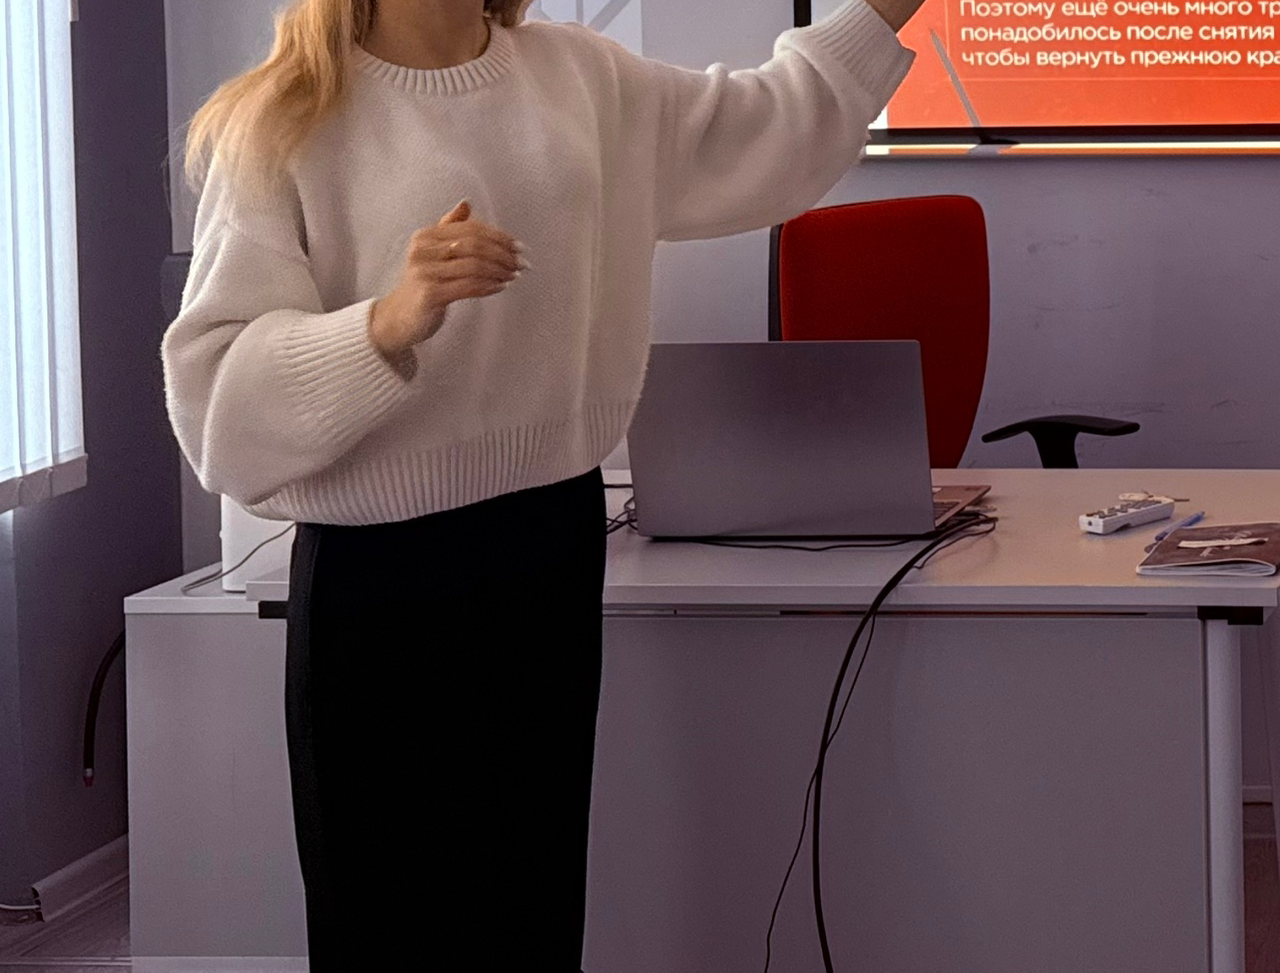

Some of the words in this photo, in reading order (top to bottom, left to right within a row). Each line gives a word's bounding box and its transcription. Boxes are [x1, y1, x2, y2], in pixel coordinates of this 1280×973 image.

[1113, 0, 1180, 16] очень
[1184, 0, 1253, 16] много
[960, 22, 1122, 44] понадобилось
[1126, 25, 1194, 41] после
[1198, 25, 1275, 41] снятия
[961, 48, 1030, 66] чтобы
[1036, 50, 1126, 69] вернуть
[1130, 50, 1242, 68] прежнюю
